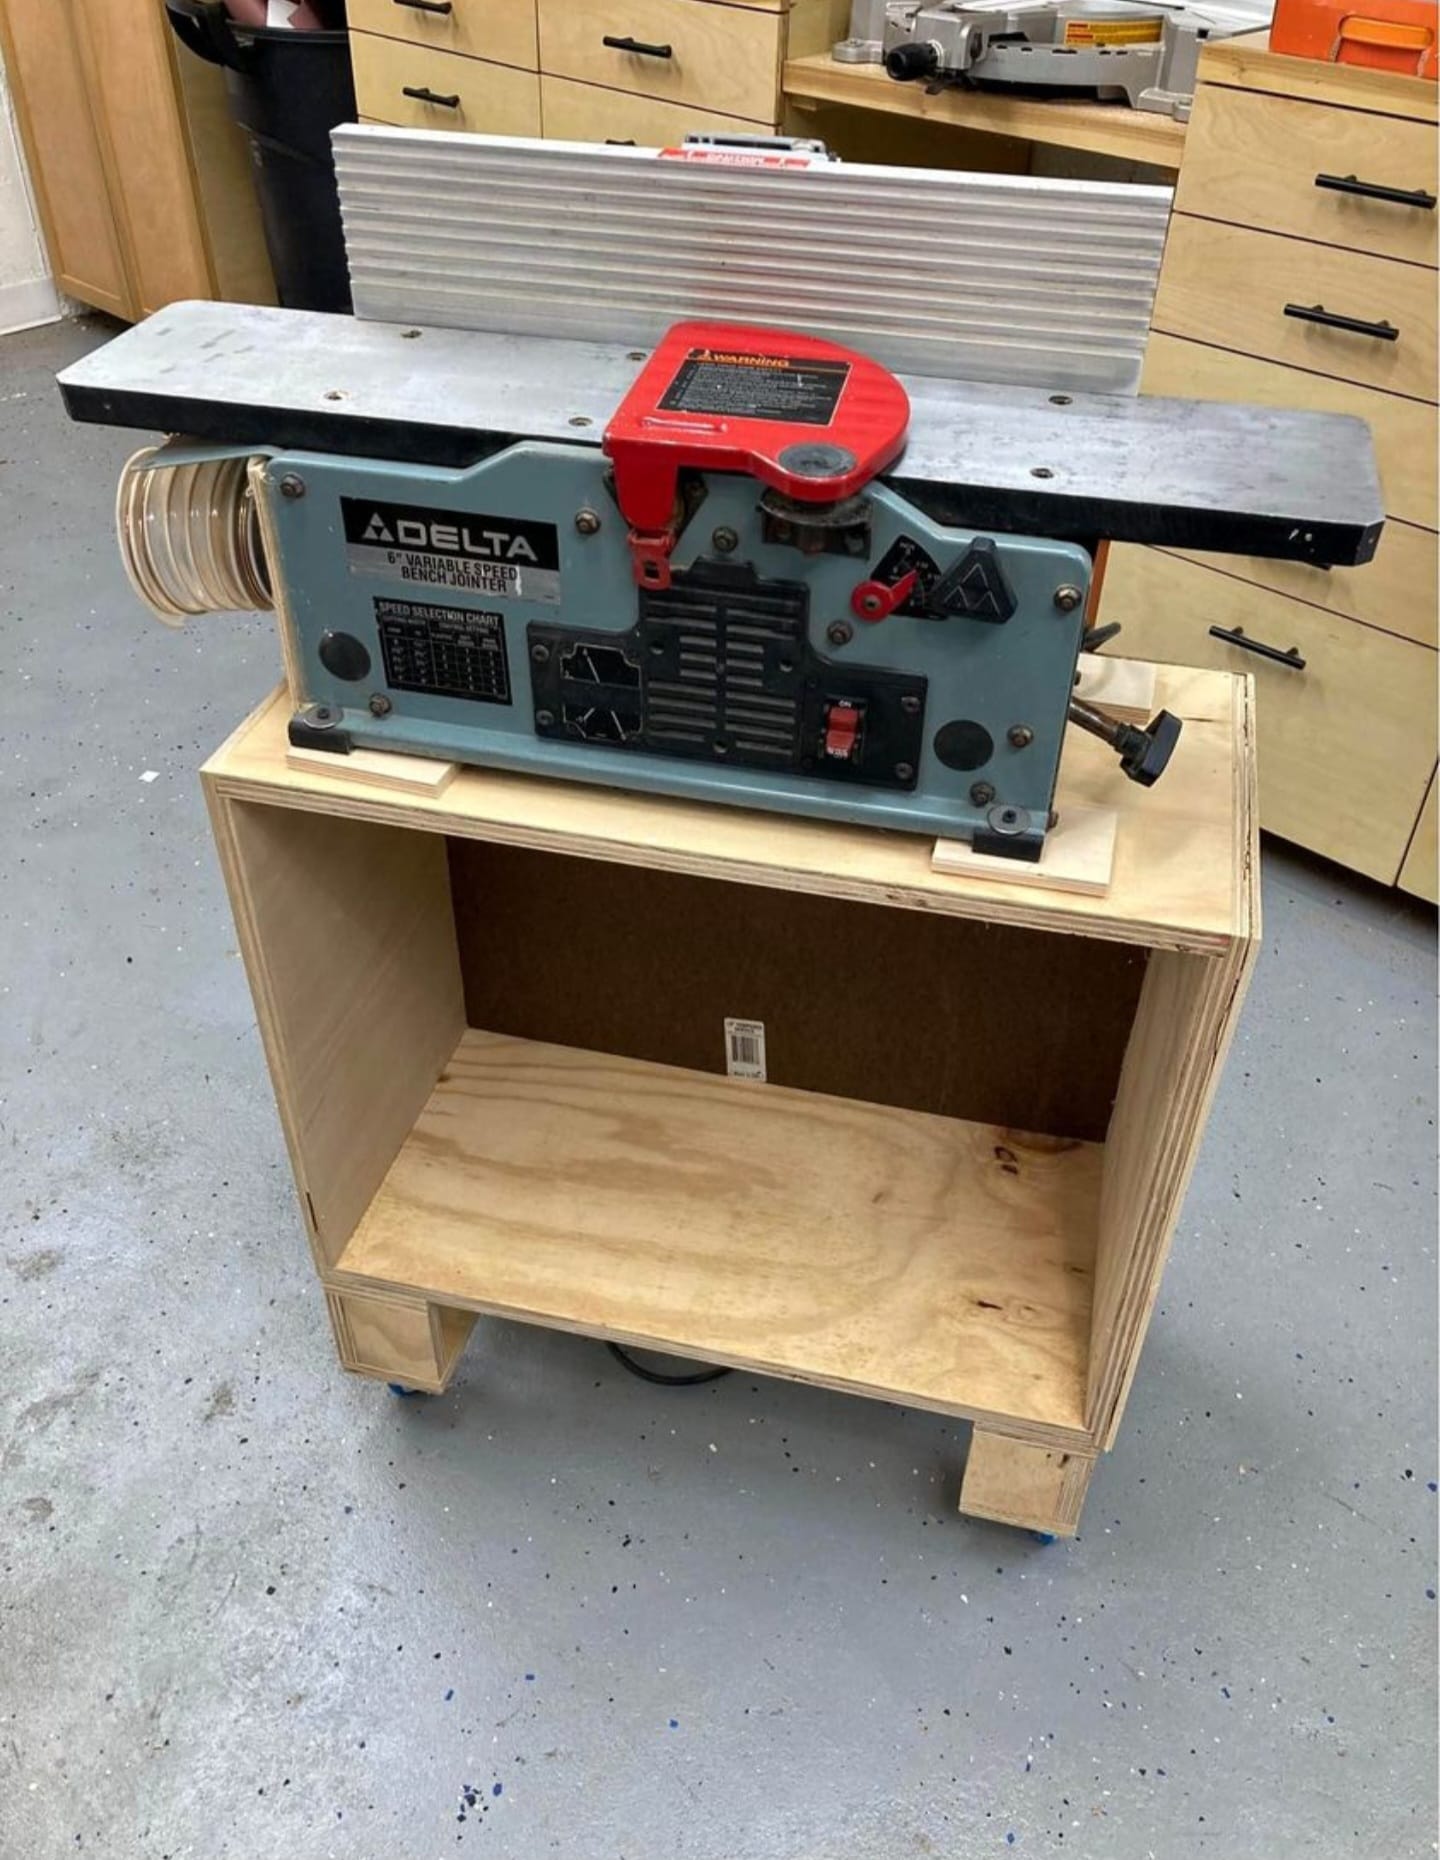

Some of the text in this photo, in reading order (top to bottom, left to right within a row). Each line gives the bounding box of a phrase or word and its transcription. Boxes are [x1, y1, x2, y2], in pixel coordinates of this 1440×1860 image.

[714, 354, 789, 368] WARNING
[397, 520, 537, 561] DELTA
[388, 551, 517, 581] 6" VARIABLE SPEED
[402, 566, 507, 593] BENCH JOINTER
[380, 602, 411, 614] SPEED
[412, 605, 464, 622] SELECTION
[466, 613, 499, 626] CHART
